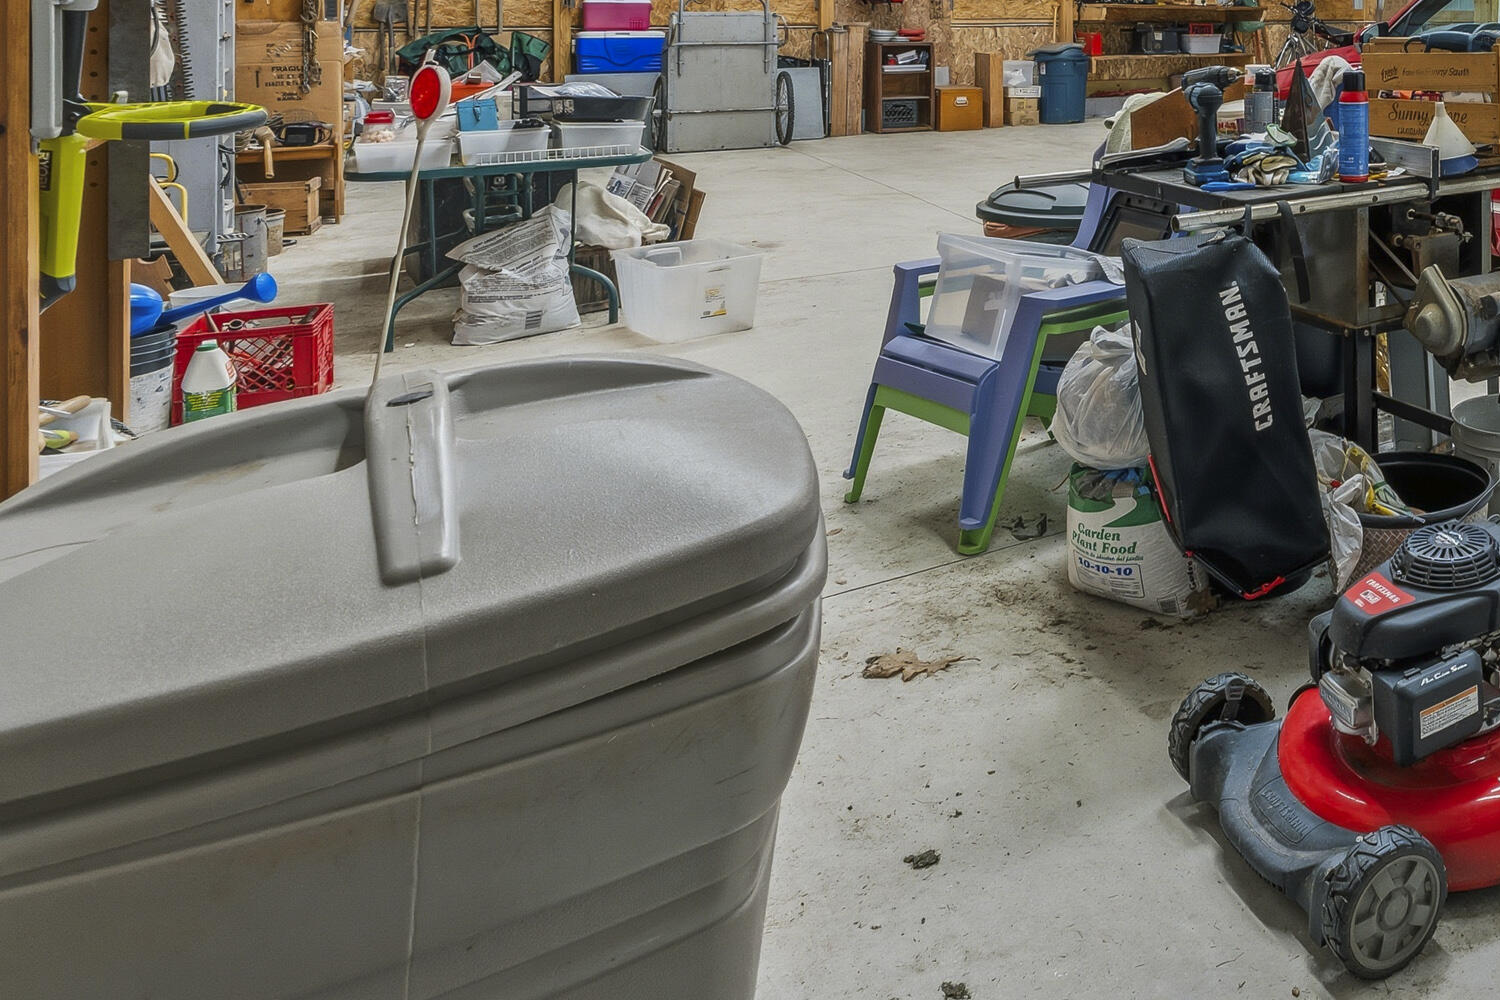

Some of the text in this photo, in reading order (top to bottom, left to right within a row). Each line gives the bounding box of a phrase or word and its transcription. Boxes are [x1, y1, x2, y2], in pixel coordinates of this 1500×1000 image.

[1219, 284, 1274, 431] CRAFTSMAN
[1072, 530, 1138, 555] Plant Food
[1078, 522, 1121, 542] Garden
[1078, 556, 1133, 576] 10-10-10
